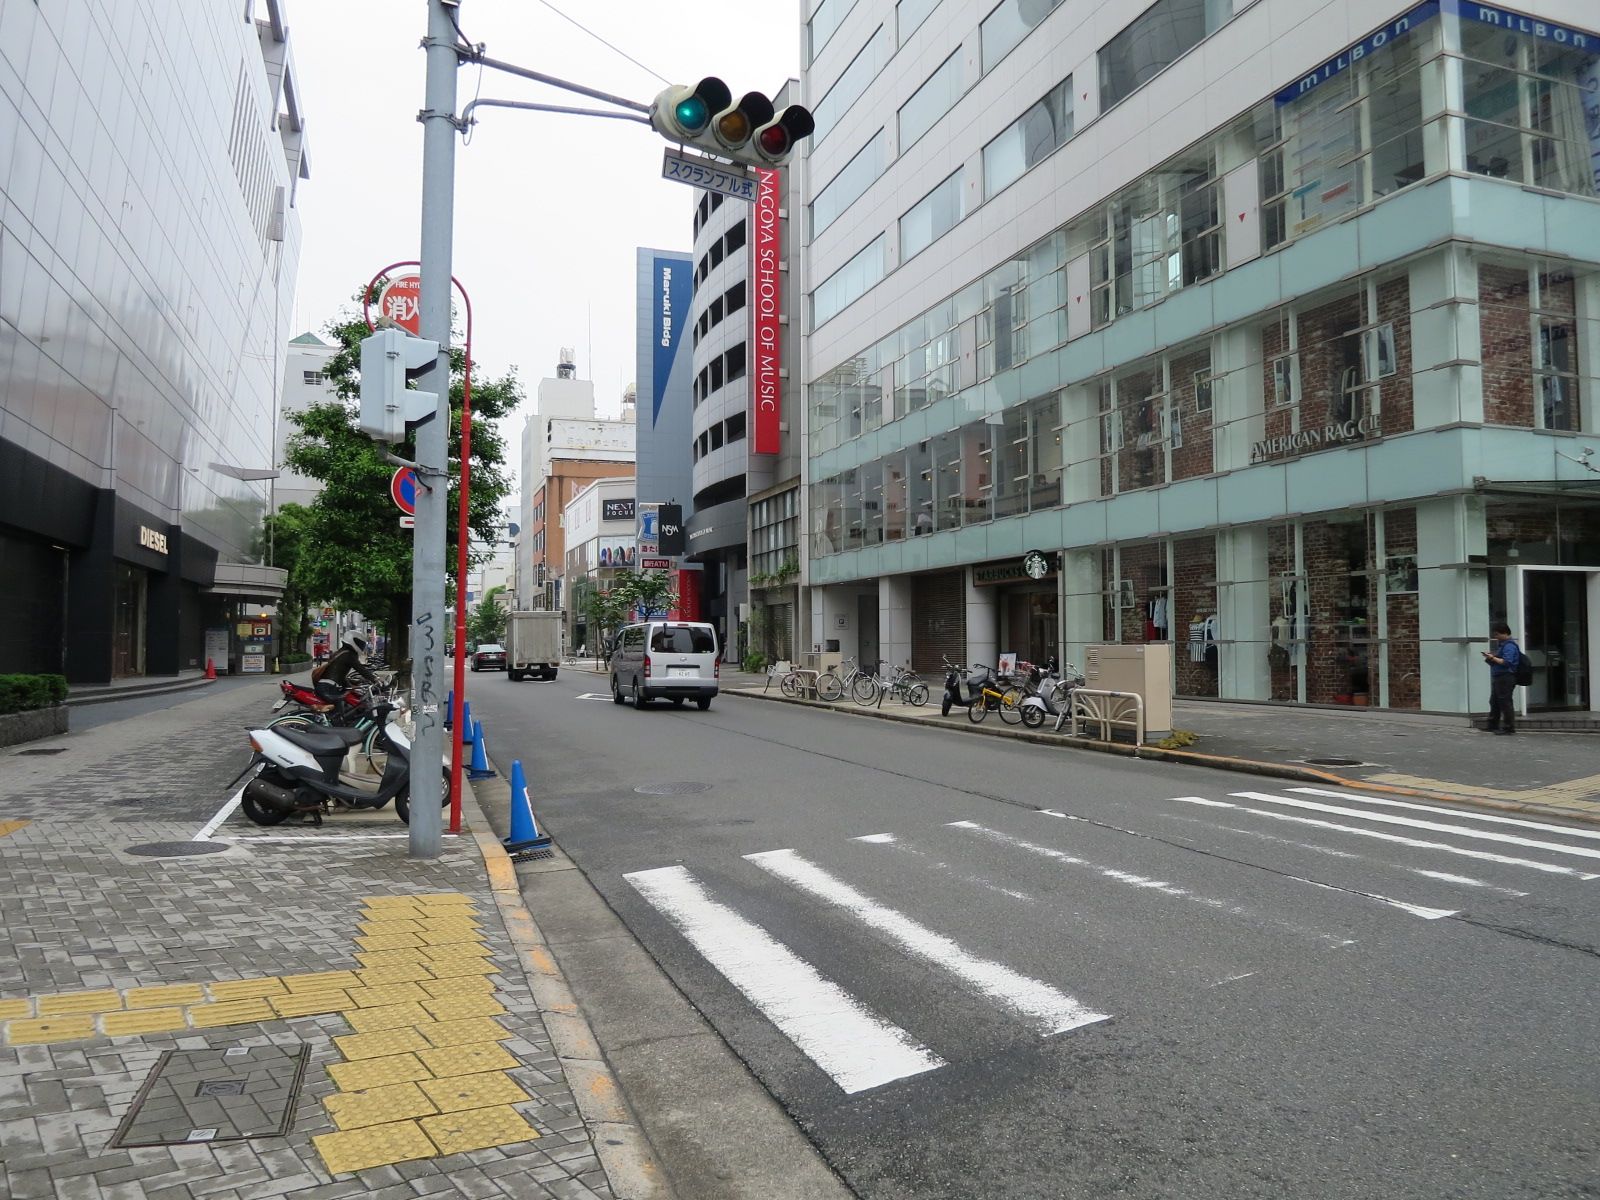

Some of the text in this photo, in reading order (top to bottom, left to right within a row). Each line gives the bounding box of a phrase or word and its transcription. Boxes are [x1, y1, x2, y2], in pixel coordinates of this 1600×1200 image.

[669, 161, 753, 198] スクランブル式
[396, 281, 409, 289] FIRE
[663, 267, 672, 316] Maruki
[760, 171, 774, 412] NAGOYA SCHOOL OF MUSIC
[1251, 429, 1320, 458] AMERICAN
[1325, 420, 1355, 441] RAG
[140, 525, 169, 555] DIESEL
[661, 524, 679, 536] NSM
